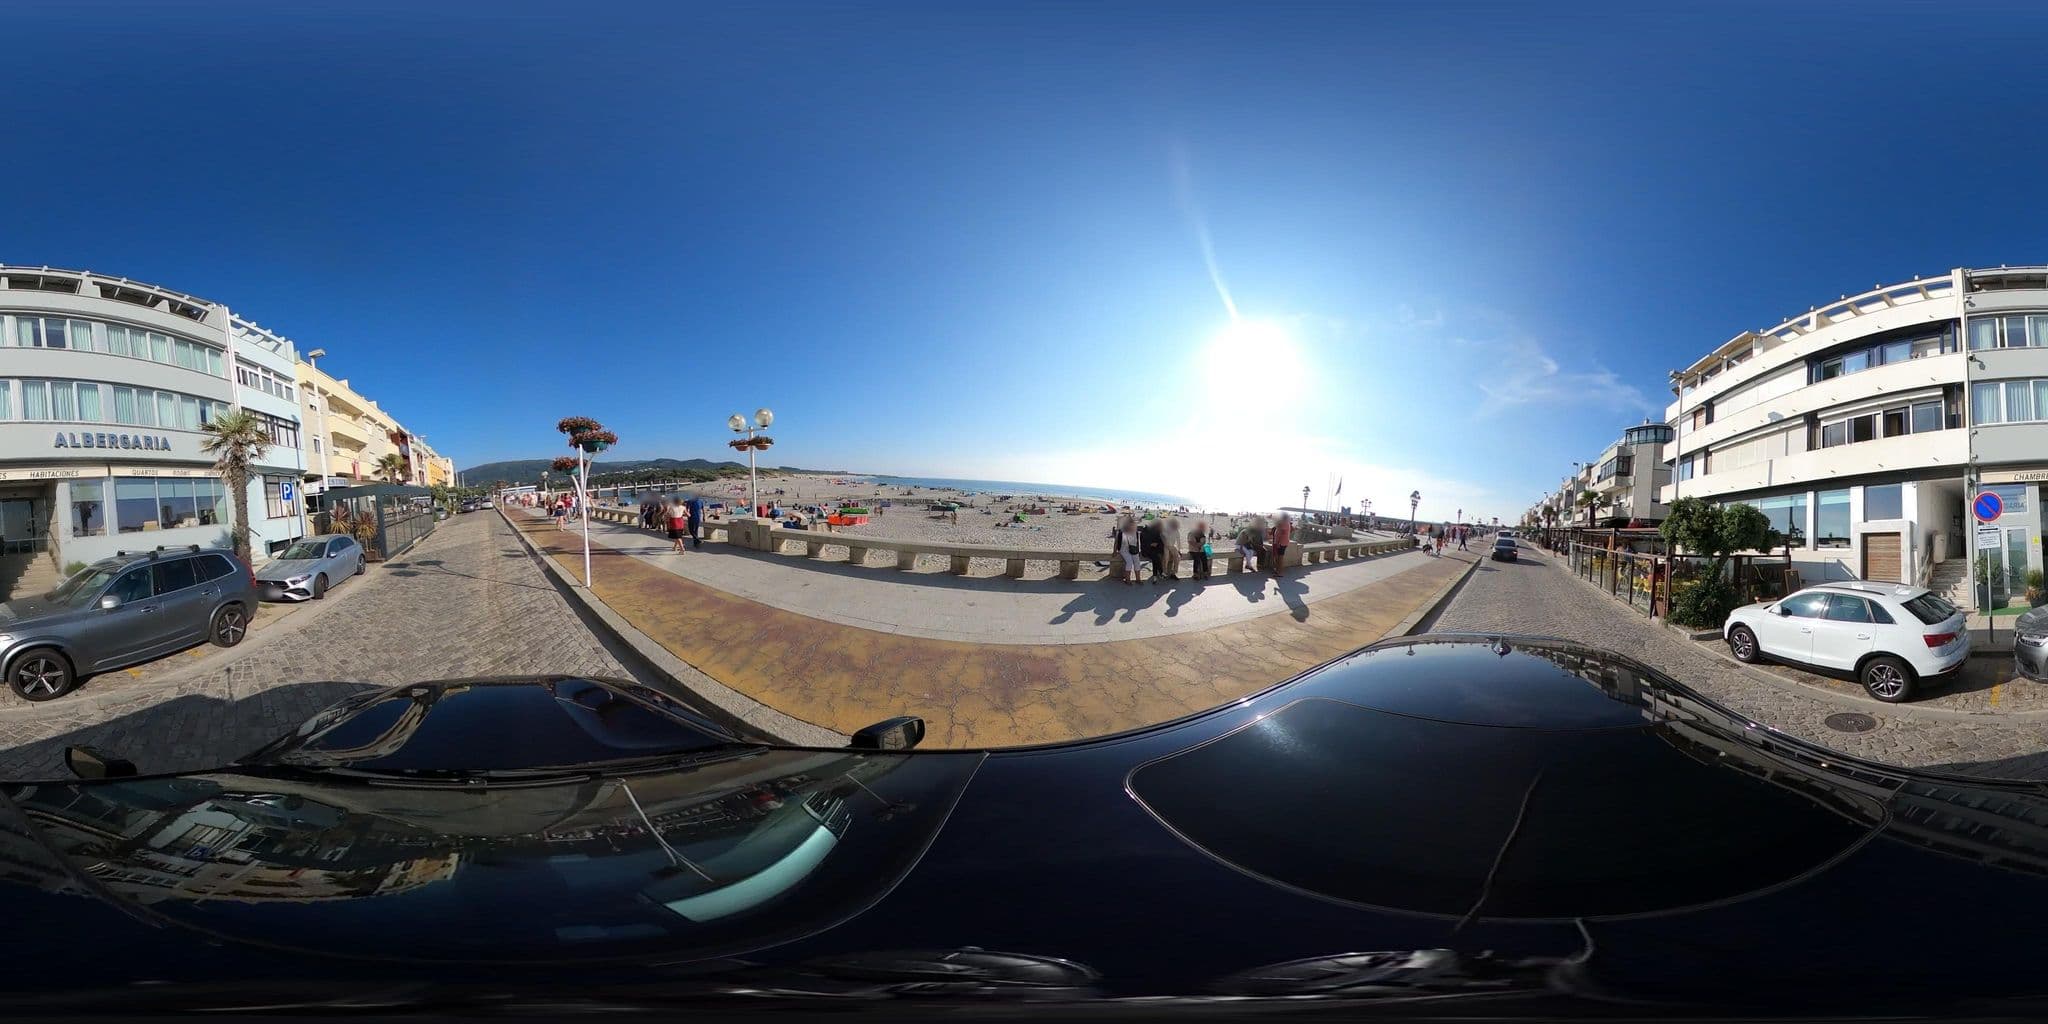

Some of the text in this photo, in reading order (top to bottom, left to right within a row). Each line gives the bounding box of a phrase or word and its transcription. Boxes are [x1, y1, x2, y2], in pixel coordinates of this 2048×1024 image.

[54, 432, 172, 451] ALBERGARIA
[30, 470, 79, 478] HABITACIONES
[284, 483, 291, 499] P
